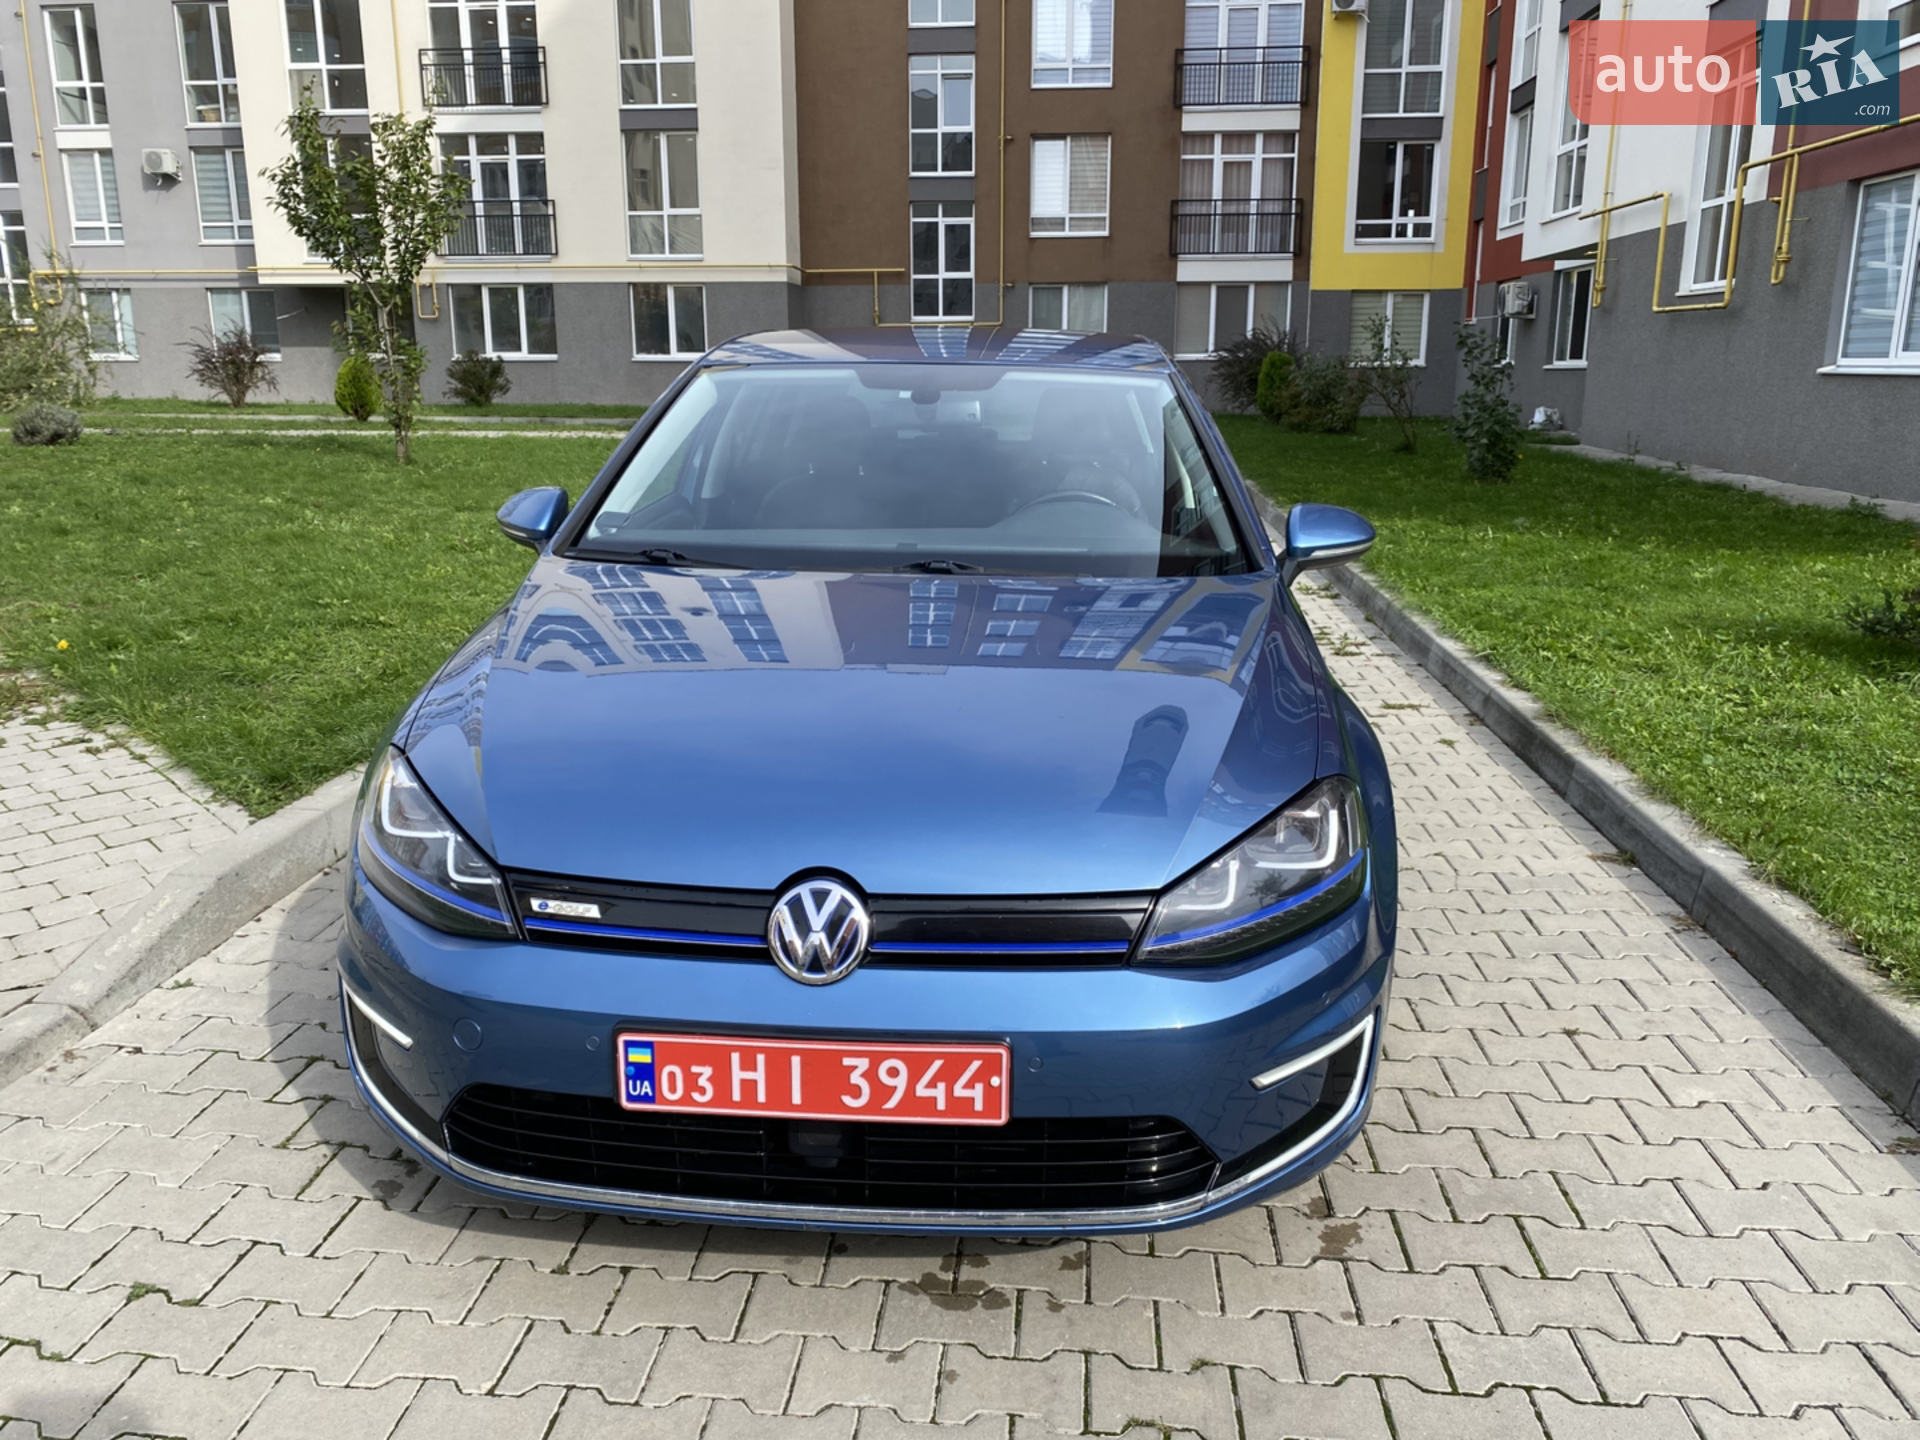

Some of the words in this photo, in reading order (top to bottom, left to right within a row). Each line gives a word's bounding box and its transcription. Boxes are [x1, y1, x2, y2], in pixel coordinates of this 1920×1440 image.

[628, 1079, 653, 1097] UA
[660, 1064, 714, 1103] 03
[840, 1056, 985, 1112] 3944
